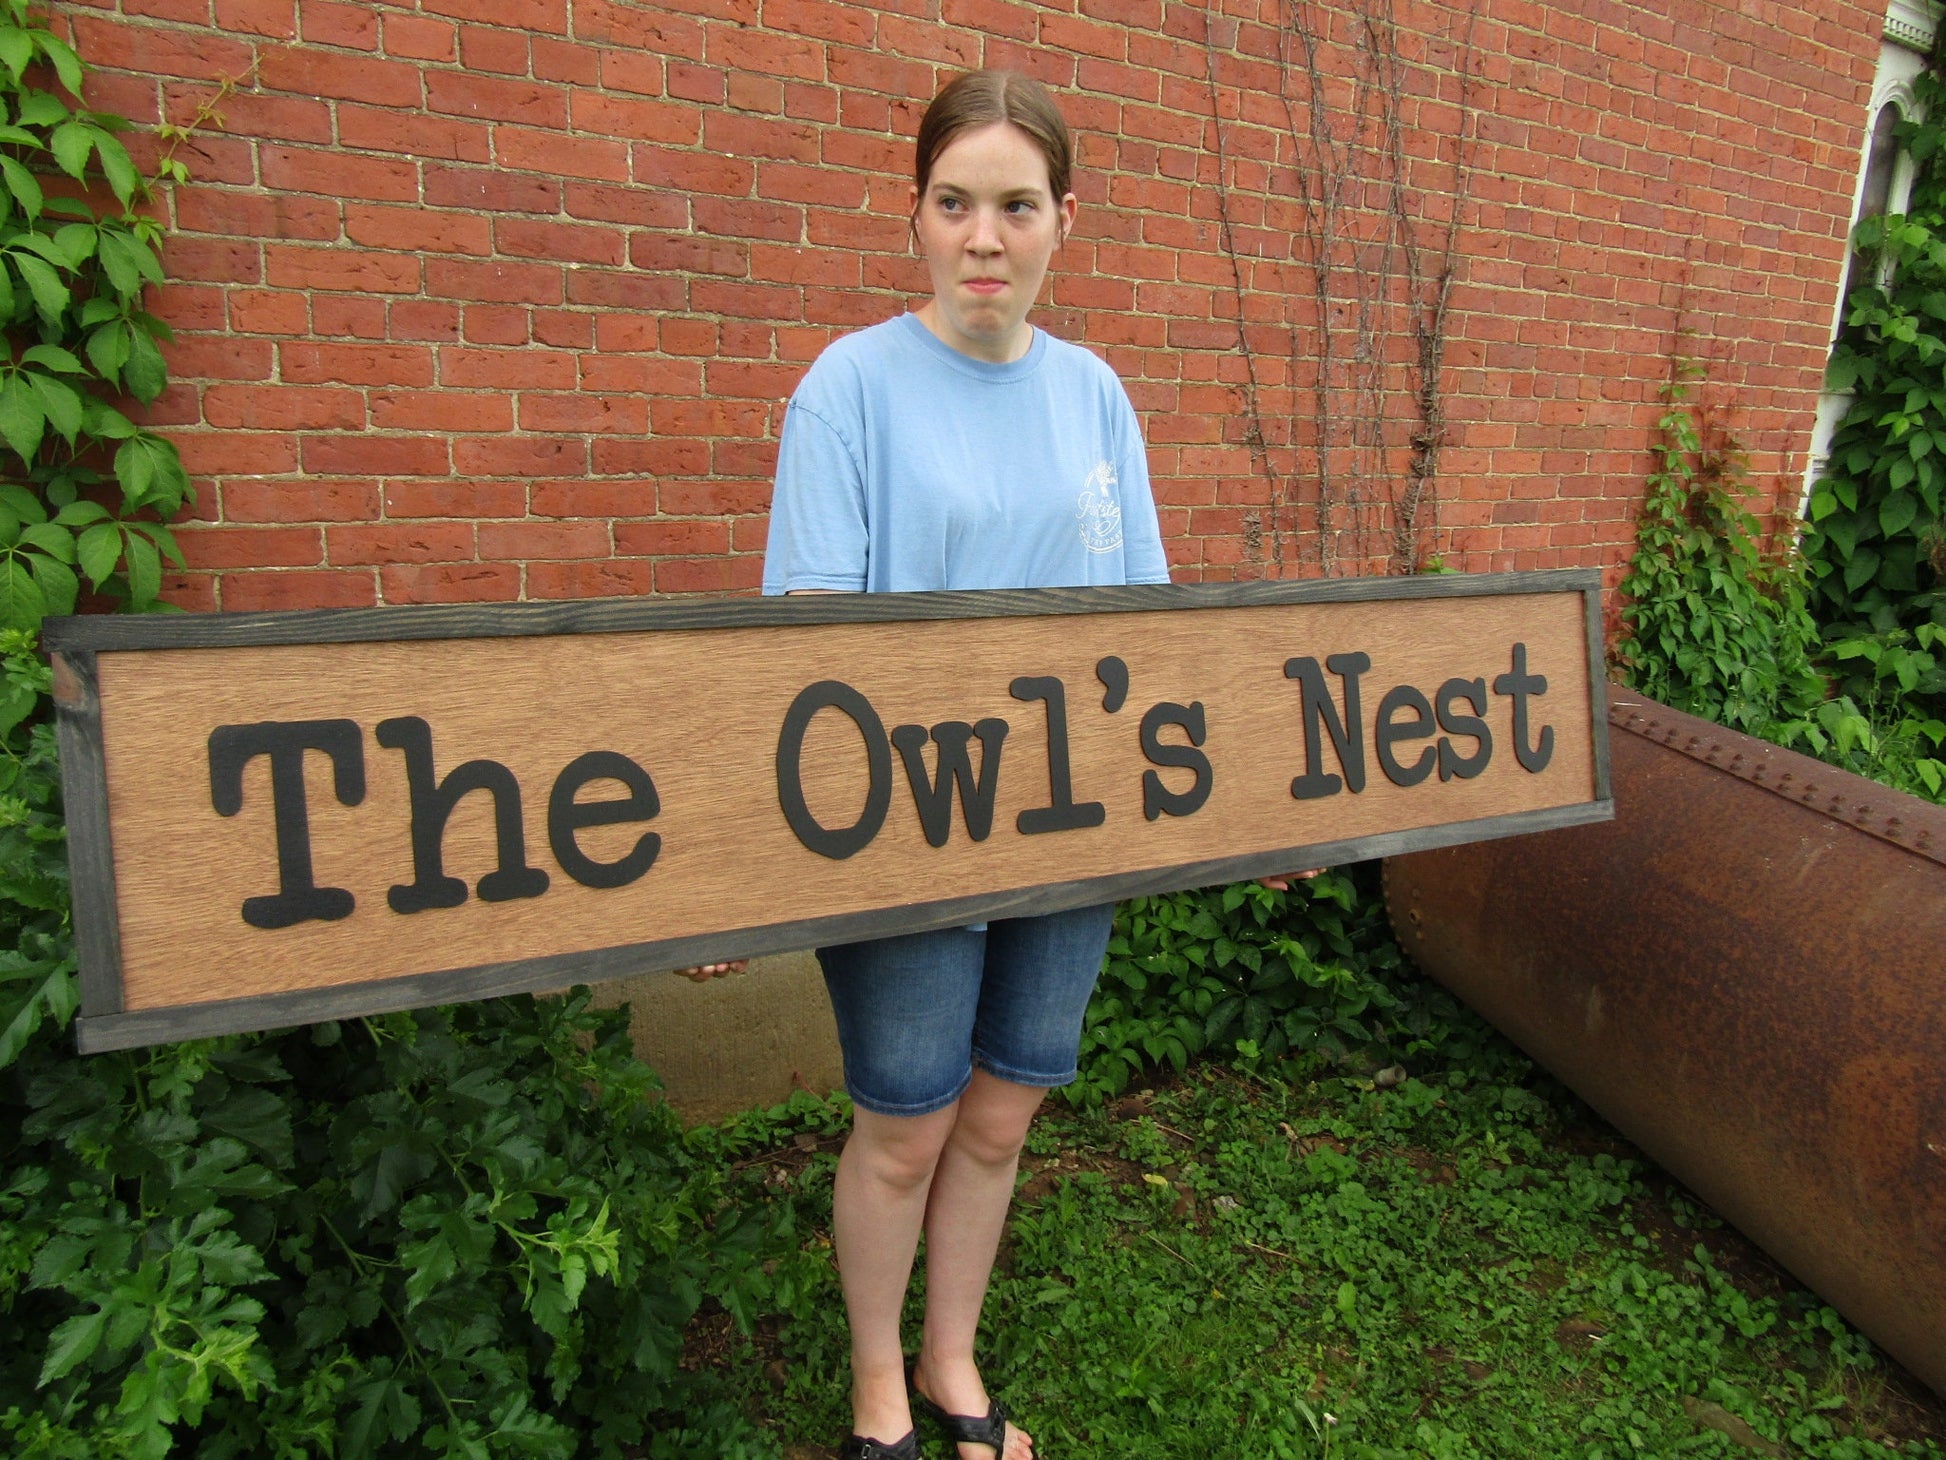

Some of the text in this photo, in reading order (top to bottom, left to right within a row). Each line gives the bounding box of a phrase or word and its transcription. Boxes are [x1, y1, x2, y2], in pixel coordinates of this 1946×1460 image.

[207, 642, 1554, 929] The Owl's Nest
